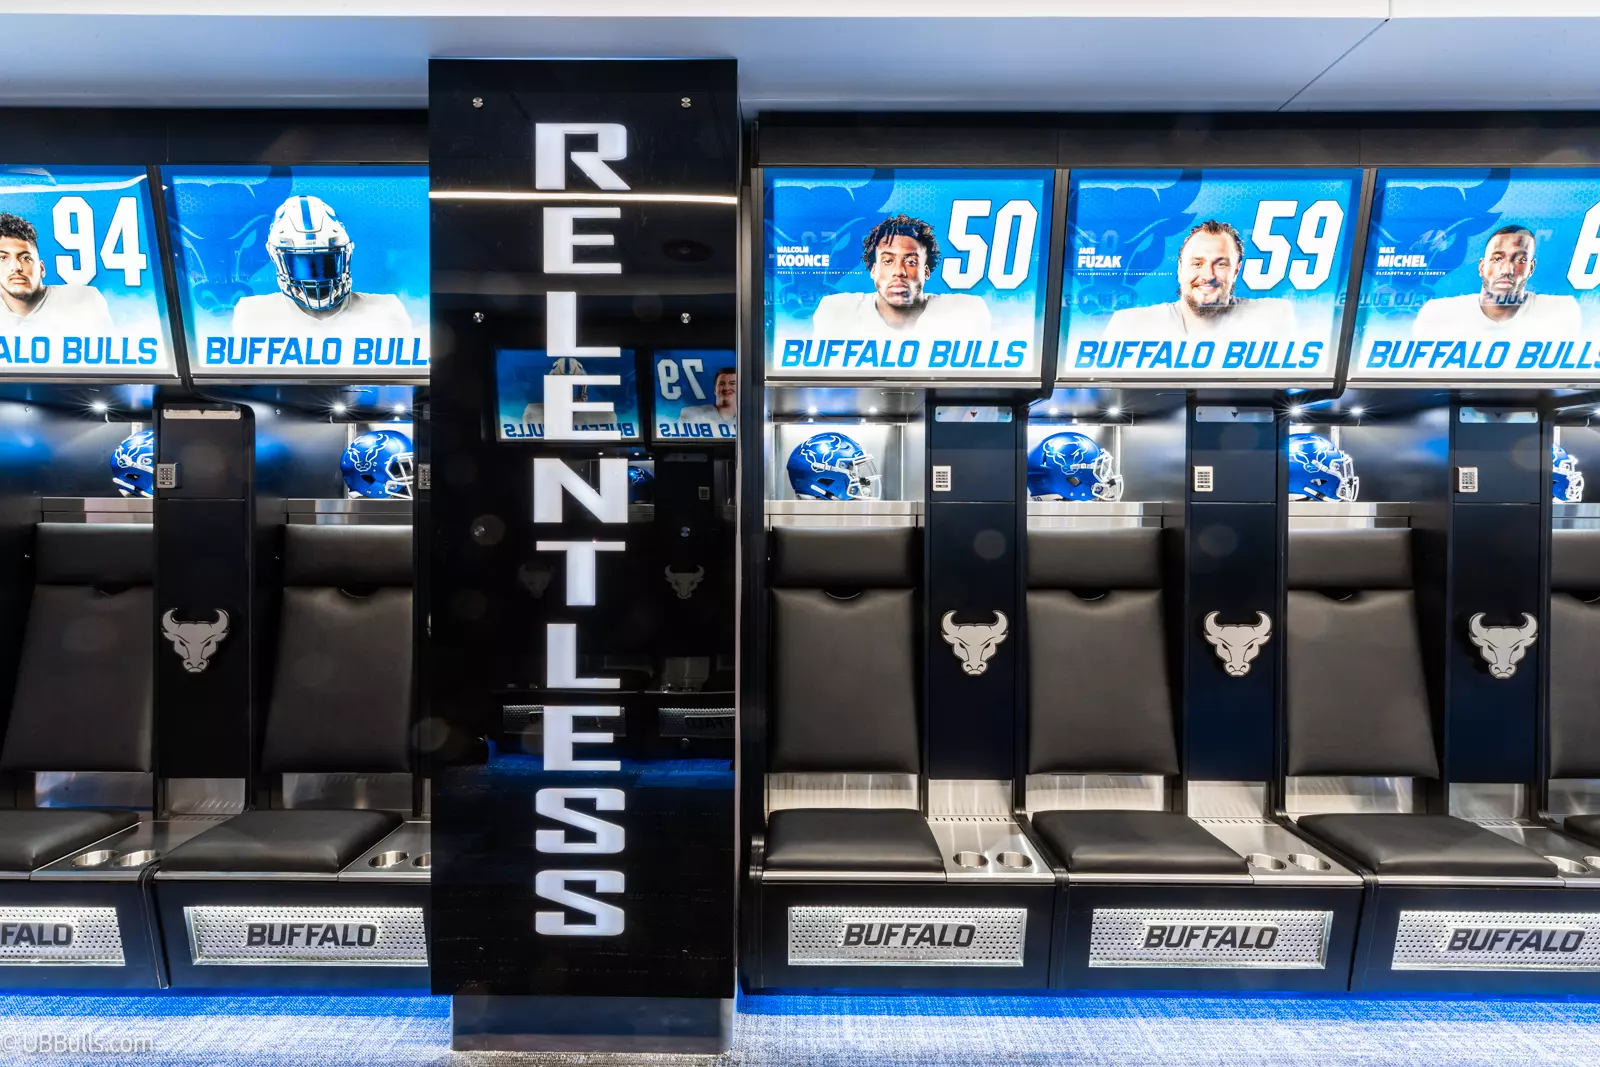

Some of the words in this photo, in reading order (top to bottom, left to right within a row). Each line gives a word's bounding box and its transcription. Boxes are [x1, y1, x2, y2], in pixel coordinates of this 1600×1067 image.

[52, 196, 147, 286] 94
[941, 200, 1038, 289] 50
[1242, 200, 1344, 290] 59
[1379, 246, 1396, 254] MAX
[777, 254, 830, 267] KOONCE
[1077, 255, 1122, 268] FUZAK
[1377, 255, 1428, 268] MICHEL
[62, 336, 158, 365] BULLS
[206, 336, 342, 365] BUFFALO
[352, 337, 431, 365] BULL
[781, 339, 921, 368] BUFFALO
[928, 340, 1028, 368] BULLS
[1074, 340, 1216, 369] BUFFALO
[1221, 341, 1324, 369] BULLS
[1366, 340, 1511, 369] BUFFALO
[1515, 341, 1600, 369] BULL
[535, 122, 630, 937] RELENTLESS
[246, 923, 378, 947] BUFFALO
[842, 923, 977, 948] BUFFALO
[1143, 925, 1280, 950] BUFFALO
[1444, 927, 1586, 952] BUFFALO
